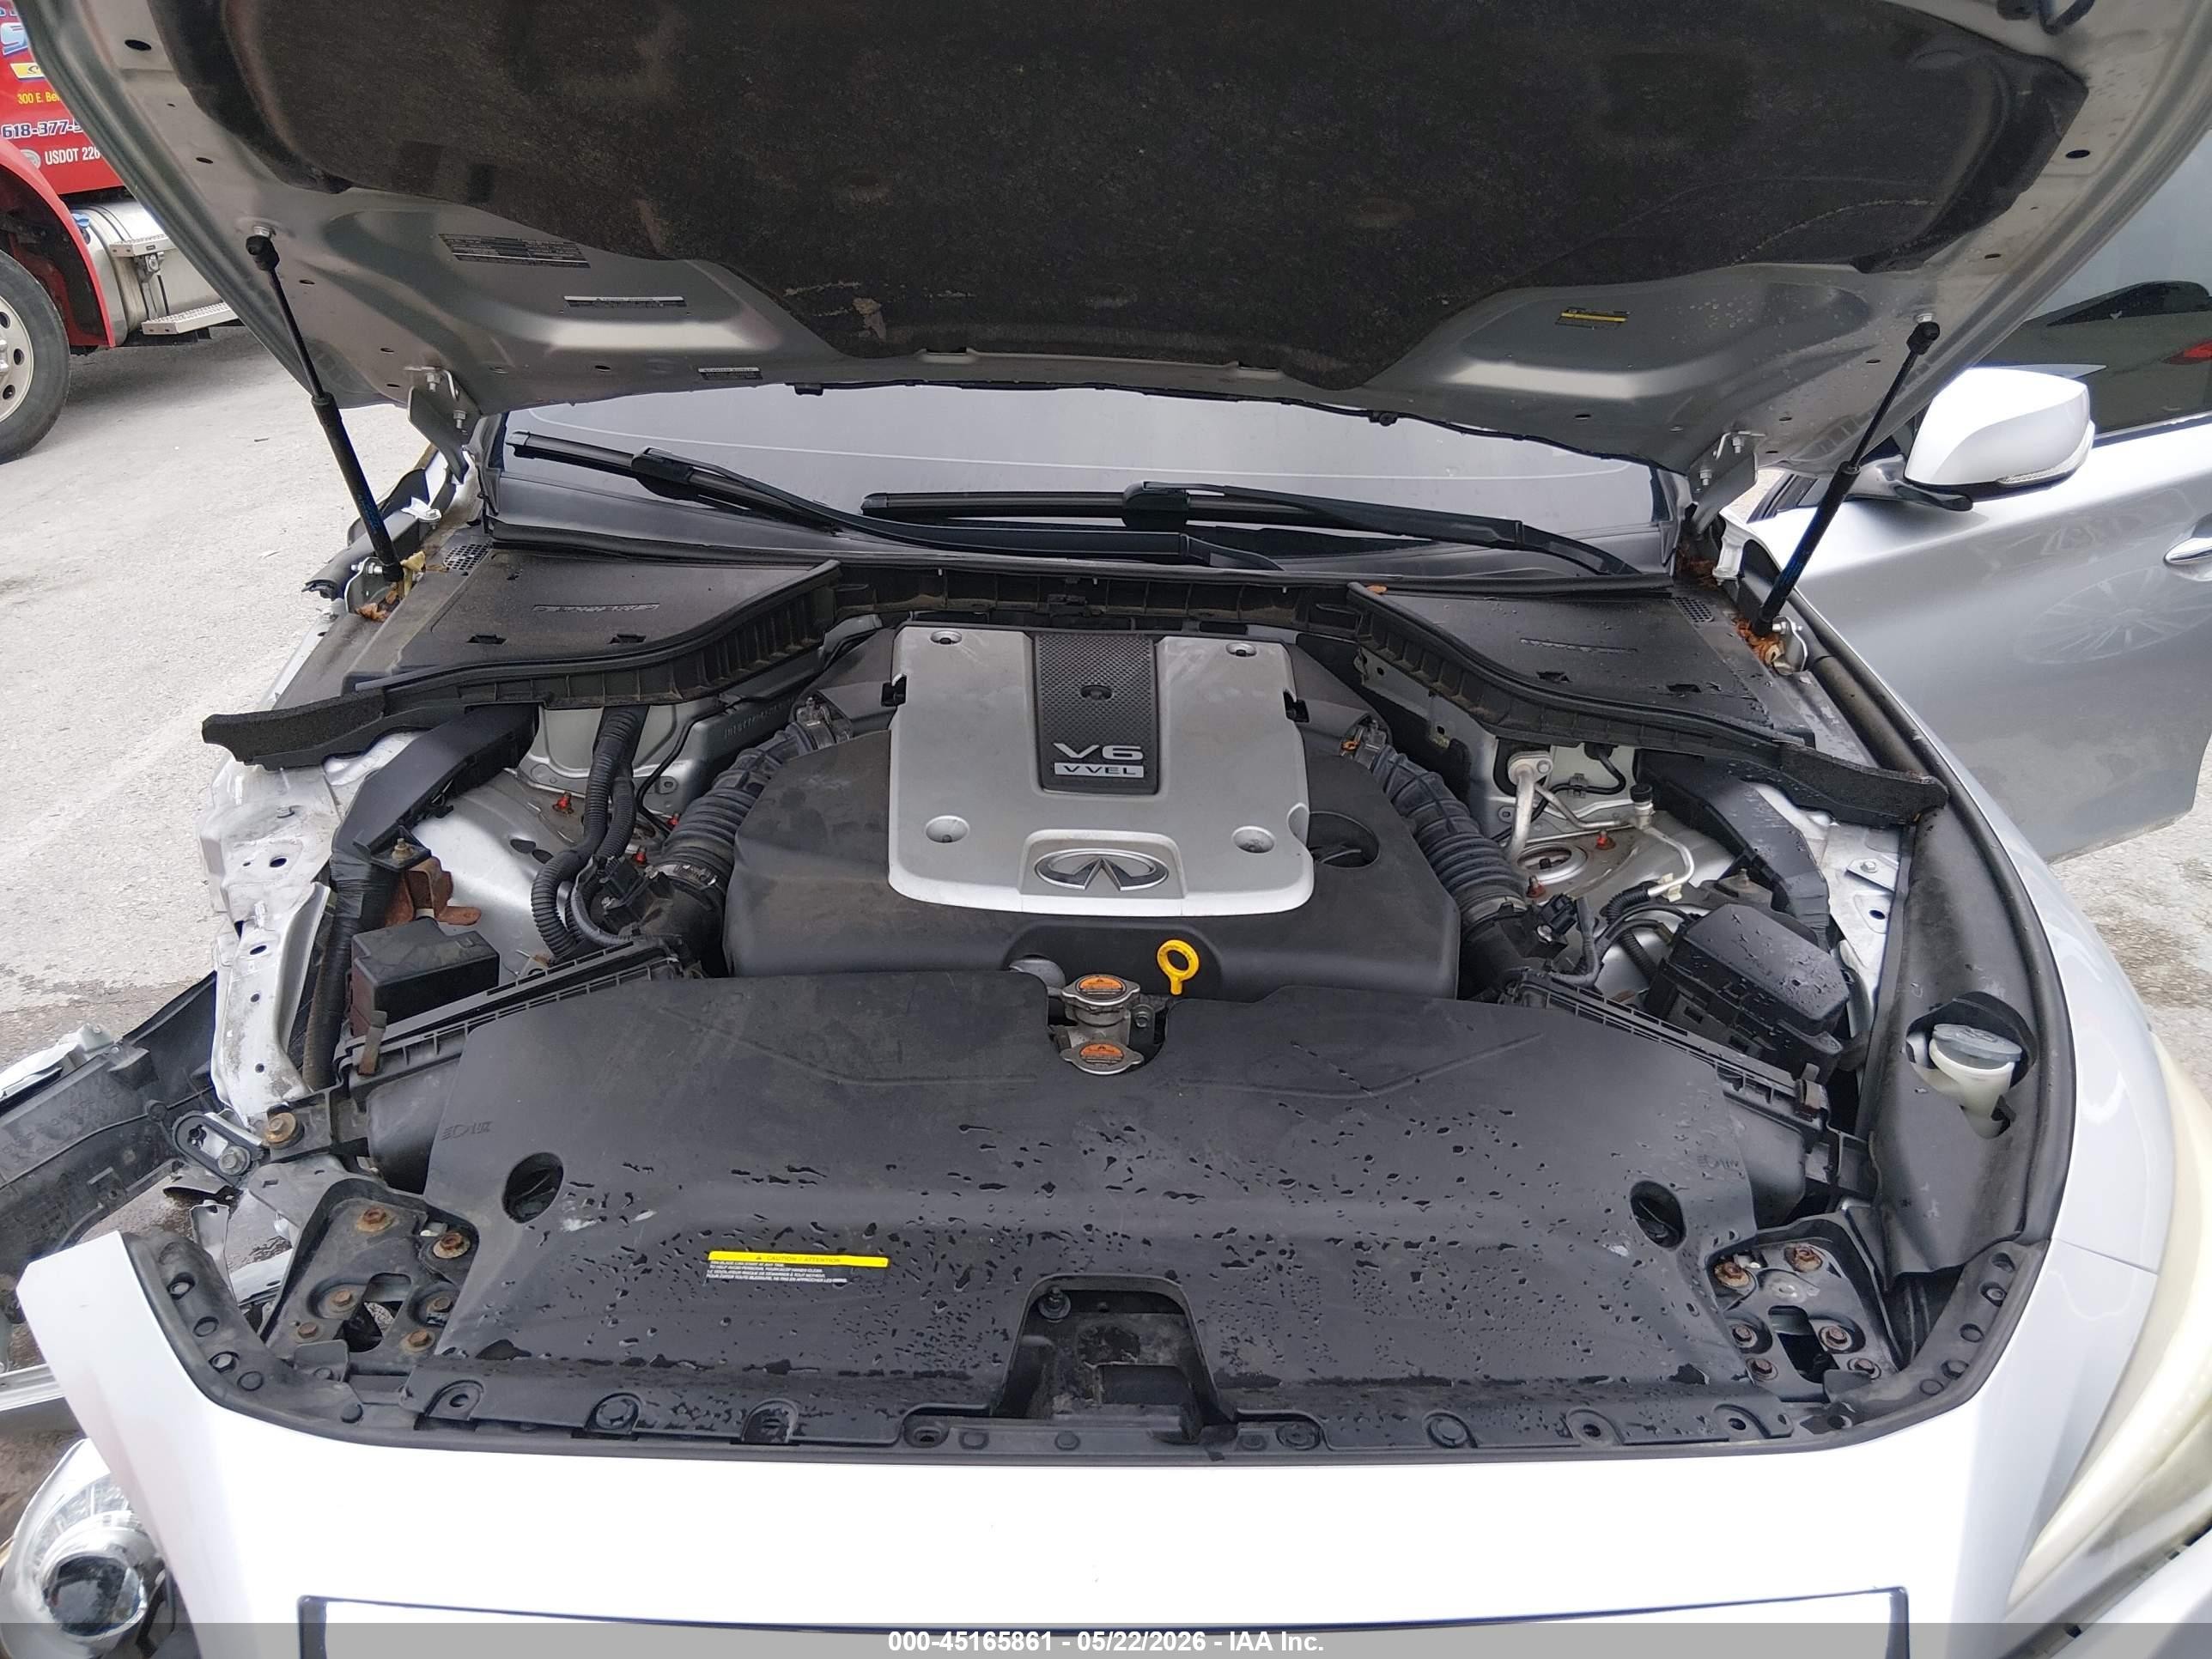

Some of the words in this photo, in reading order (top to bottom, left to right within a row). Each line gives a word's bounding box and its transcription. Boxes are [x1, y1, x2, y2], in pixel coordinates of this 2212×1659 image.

[17, 93, 34, 105] 300
[45, 148, 79, 166] USDOT
[1053, 742, 1144, 761] V6
[1063, 764, 1136, 775] VVEL
